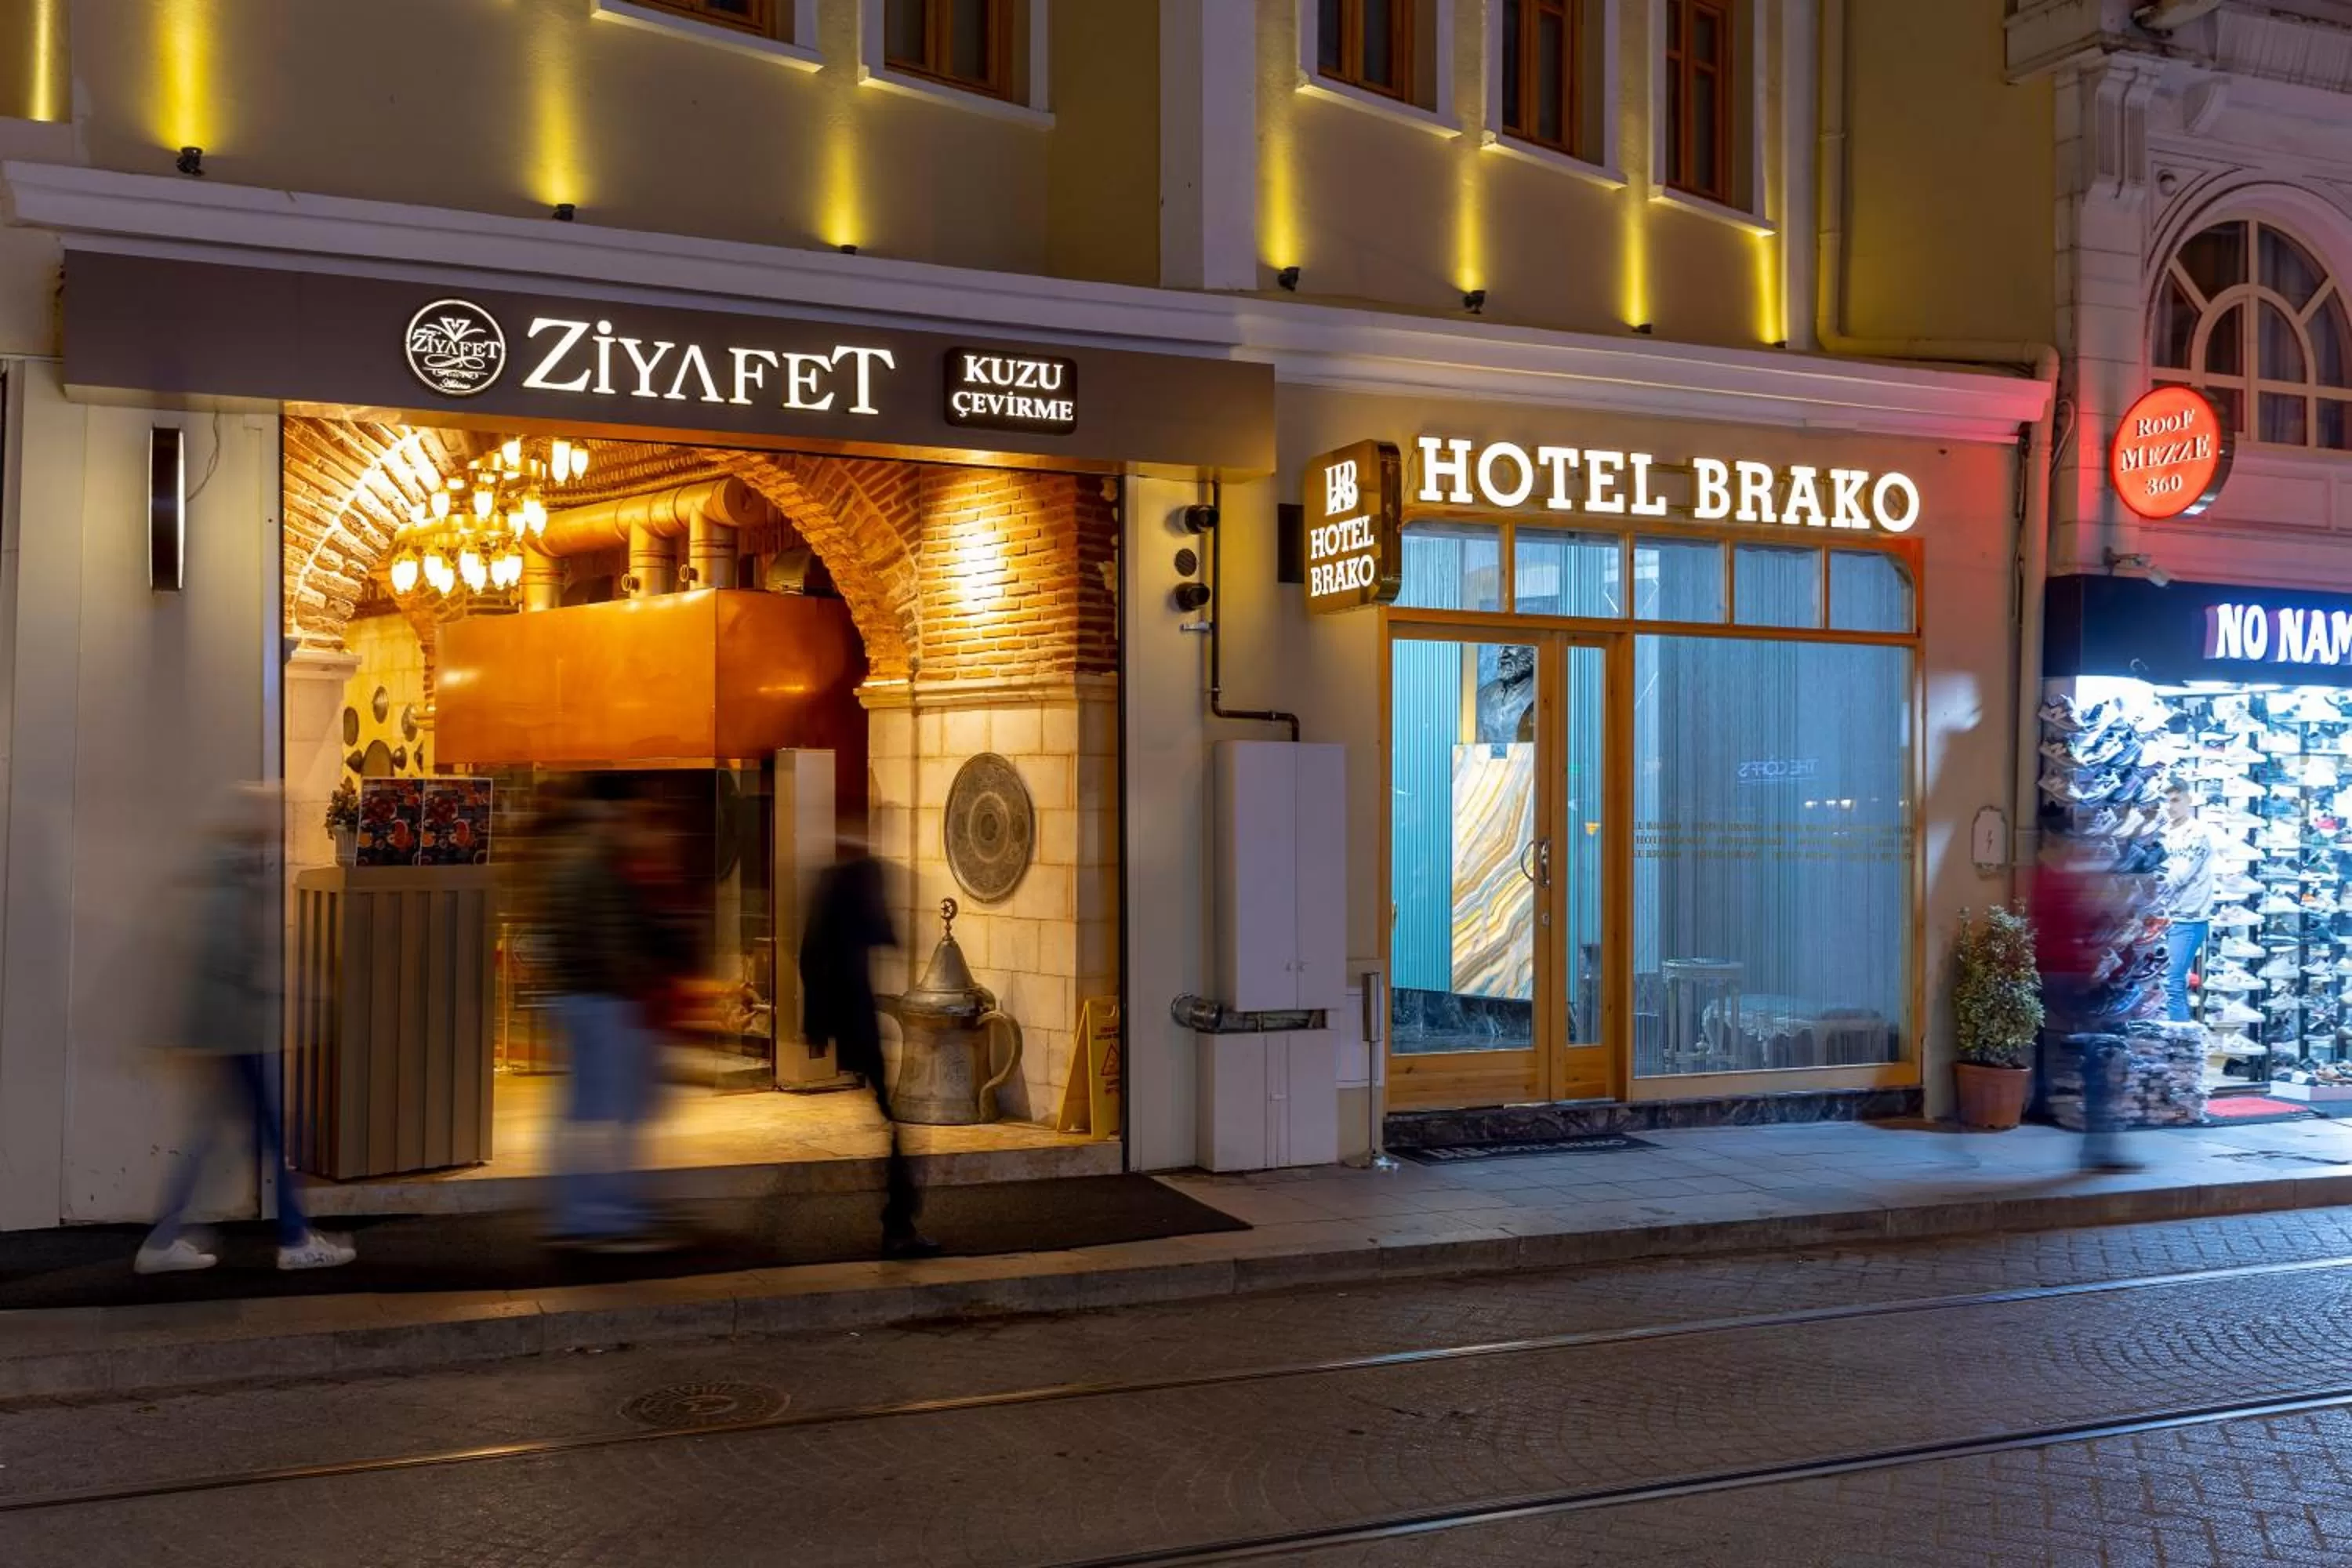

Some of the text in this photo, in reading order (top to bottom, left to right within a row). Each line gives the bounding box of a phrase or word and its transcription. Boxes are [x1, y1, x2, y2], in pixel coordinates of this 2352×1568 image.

[964, 354, 1064, 390] KUZU
[952, 390, 1074, 421] ÇEVİRME
[2136, 408, 2195, 438] ROOF
[2121, 433, 2212, 474] MEZZE
[1418, 437, 1920, 533] HOTEL BRAKO
[2144, 474, 2183, 496] 360
[1310, 514, 1374, 560] HOTEL
[1310, 554, 1375, 597] BRAKO
[2213, 603, 2269, 661] NO
